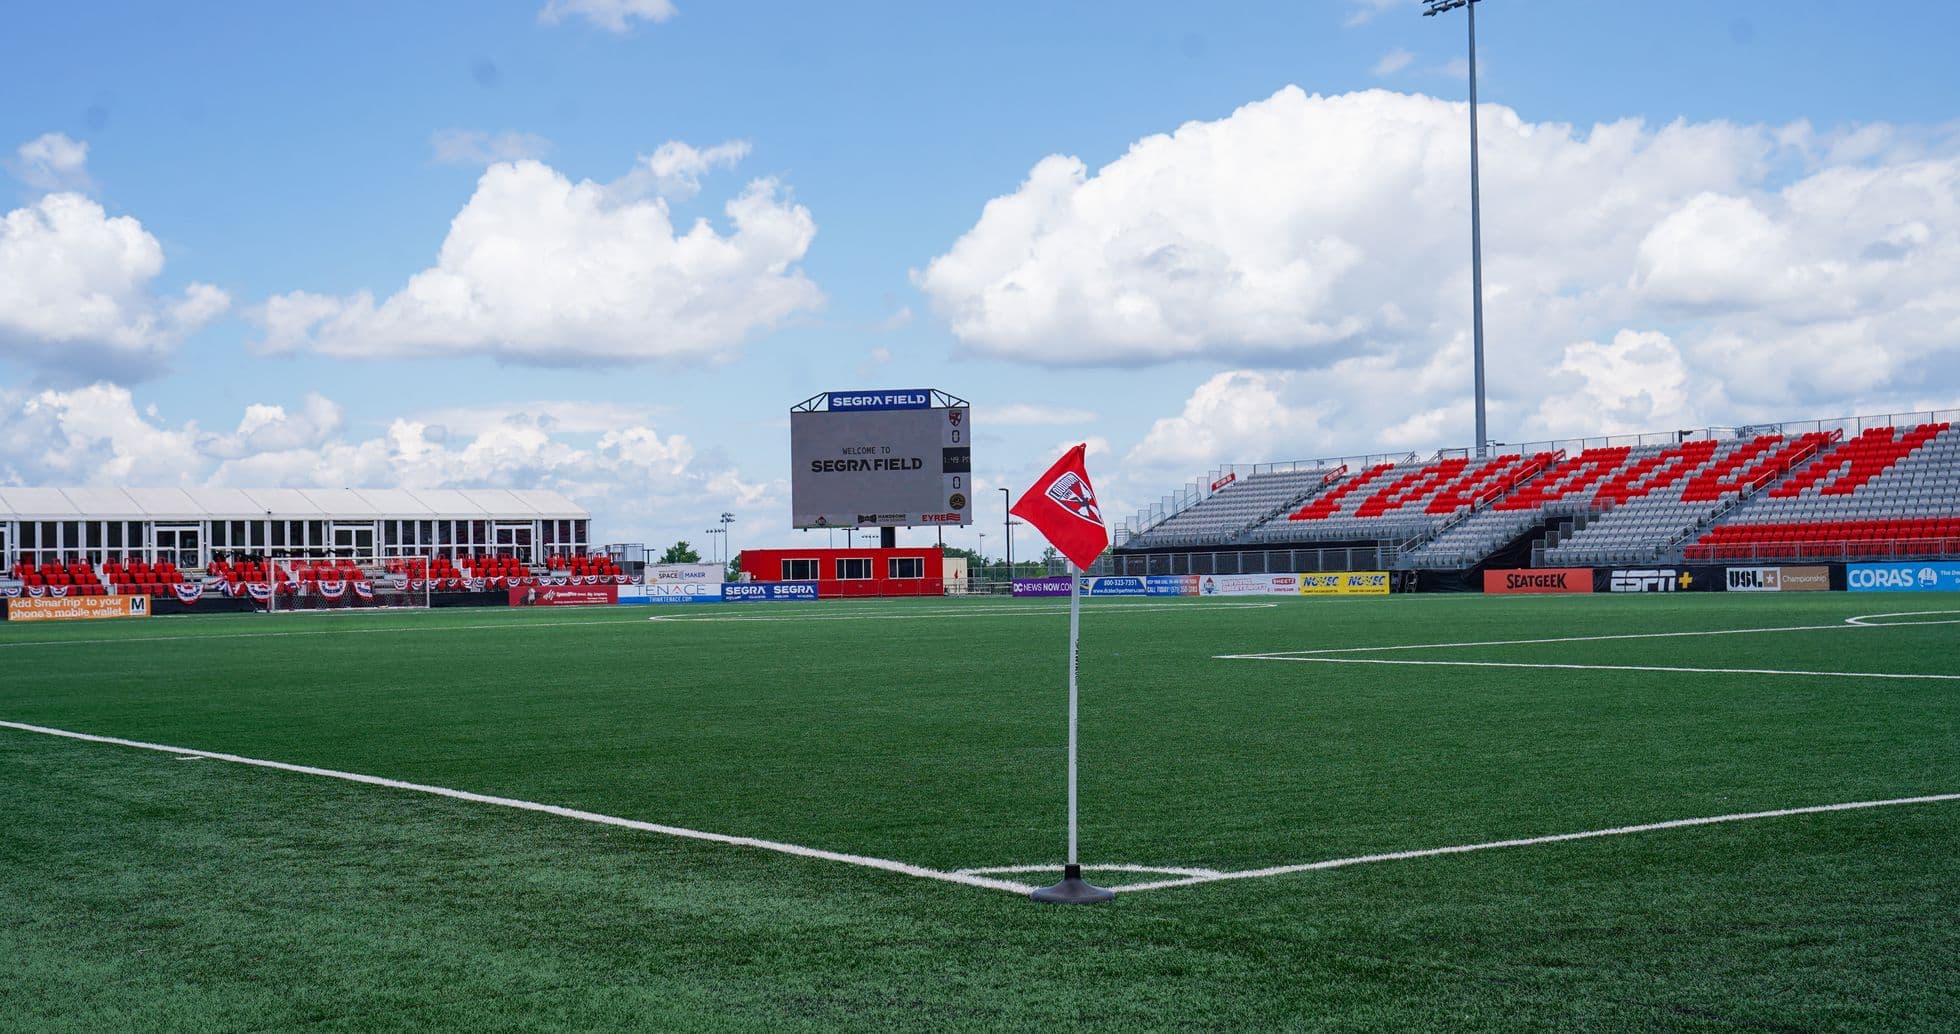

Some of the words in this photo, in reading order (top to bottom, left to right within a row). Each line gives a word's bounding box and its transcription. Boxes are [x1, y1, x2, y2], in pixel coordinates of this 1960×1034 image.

[833, 396, 883, 407] SEGRA
[884, 394, 926, 405] FIELD
[952, 430, 960, 443] 0
[842, 447, 876, 455] WELCOME
[881, 446, 891, 455] TO
[811, 459, 872, 473] SEGRA
[874, 458, 923, 471] FIELD
[953, 476, 961, 489] 0
[921, 514, 946, 522] EYRE
[1303, 576, 1340, 587] NOVEC
[1348, 576, 1386, 586] NOVEC
[1506, 573, 1568, 589] SEATGEEK
[1728, 570, 1763, 588] USL
[1782, 575, 1827, 584] Championship
[1848, 569, 1914, 587] CORAS
[634, 584, 706, 596] TENACE
[725, 586, 766, 595] SEGRA
[773, 585, 814, 594] SEGRA
[1013, 583, 1023, 592] DC
[1023, 583, 1042, 592] NEWS
[11, 600, 32, 608] Add
[87, 598, 97, 606] to
[100, 598, 123, 607] your
[131, 598, 144, 610] M
[10, 609, 52, 619] phone's
[55, 608, 90, 617] mobile
[92, 607, 126, 616] wallet.
